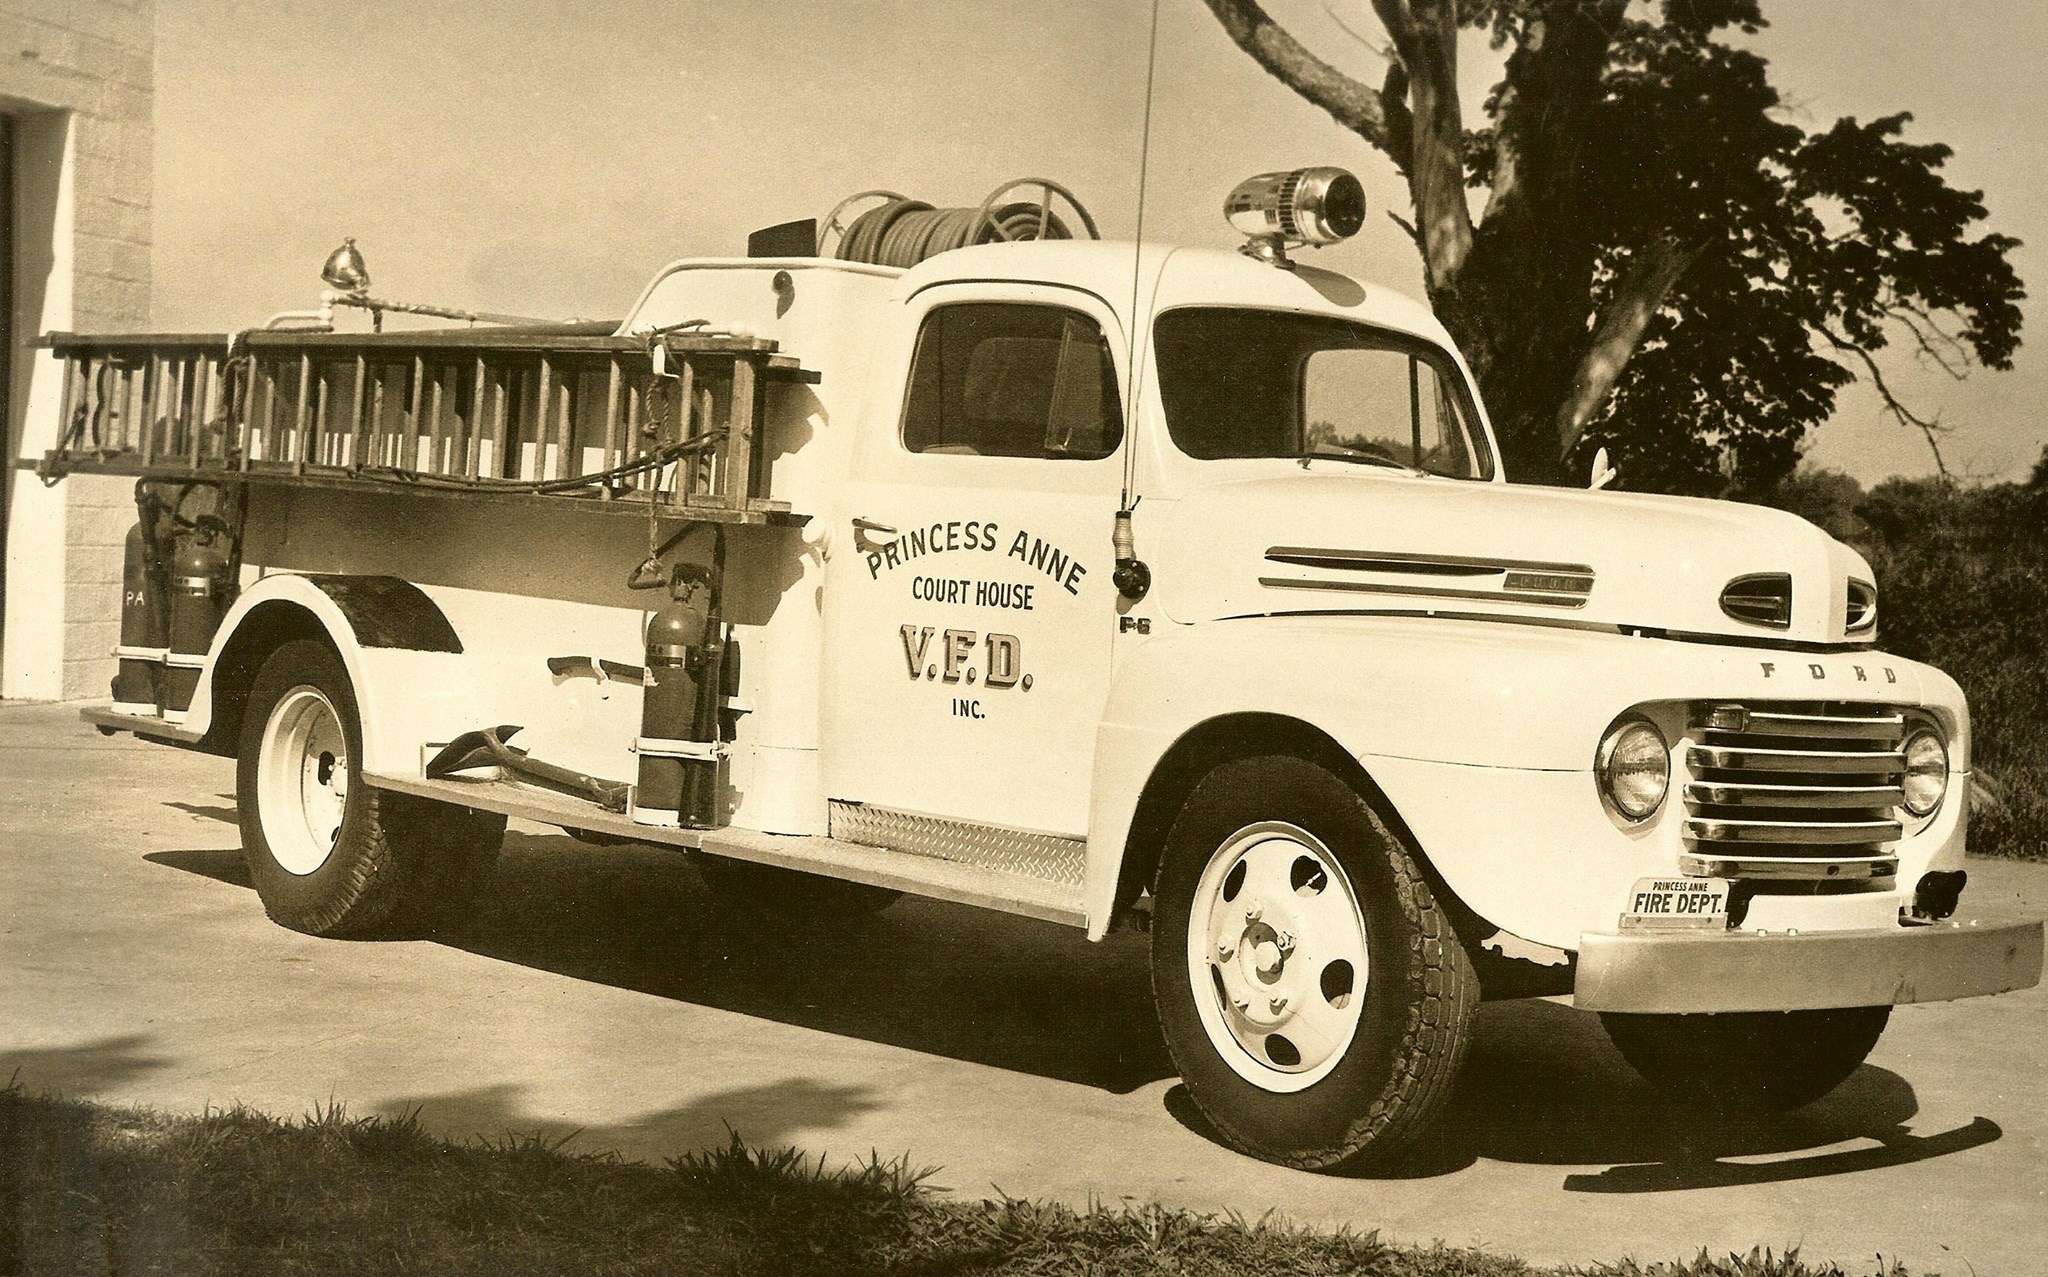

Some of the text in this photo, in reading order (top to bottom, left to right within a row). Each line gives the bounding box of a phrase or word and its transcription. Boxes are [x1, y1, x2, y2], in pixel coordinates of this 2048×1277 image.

[866, 521, 1087, 595] PRINCESS ANNE
[126, 591, 145, 606] PA
[912, 576, 1035, 610] COURT HOUSE
[899, 624, 1034, 692] V.F.D.
[1760, 662, 1897, 684] FORD
[952, 698, 985, 719] INC.
[1652, 881, 1709, 892] PRINCESS ANNE
[1633, 893, 1722, 914] FIRE DEPT.
